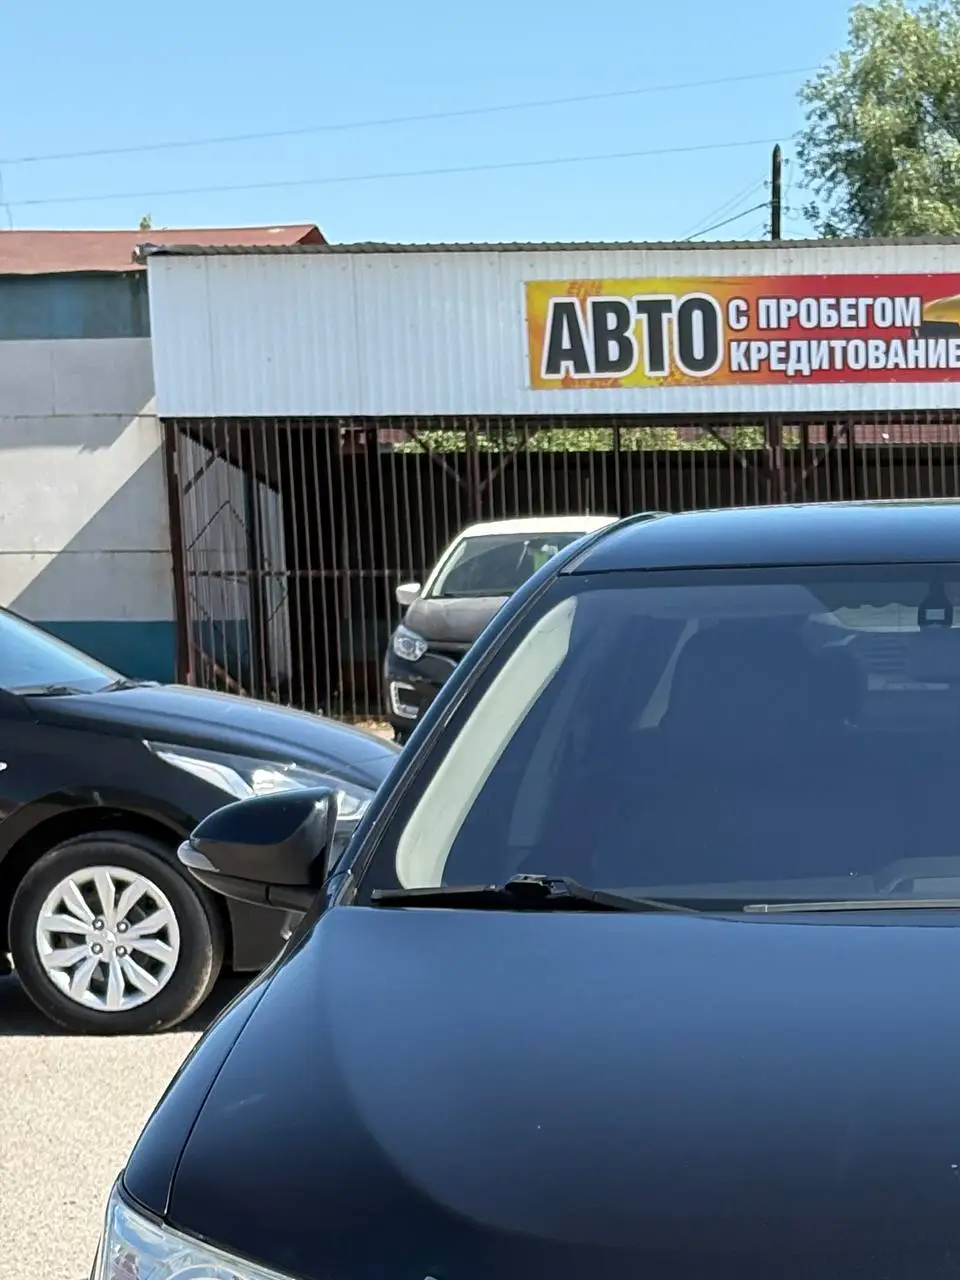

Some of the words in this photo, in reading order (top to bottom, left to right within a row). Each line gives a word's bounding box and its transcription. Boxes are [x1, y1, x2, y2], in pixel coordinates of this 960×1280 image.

[543, 295, 722, 378] АВТО
[728, 298, 747, 330] С
[759, 297, 921, 329] ПРОБЕГОМ
